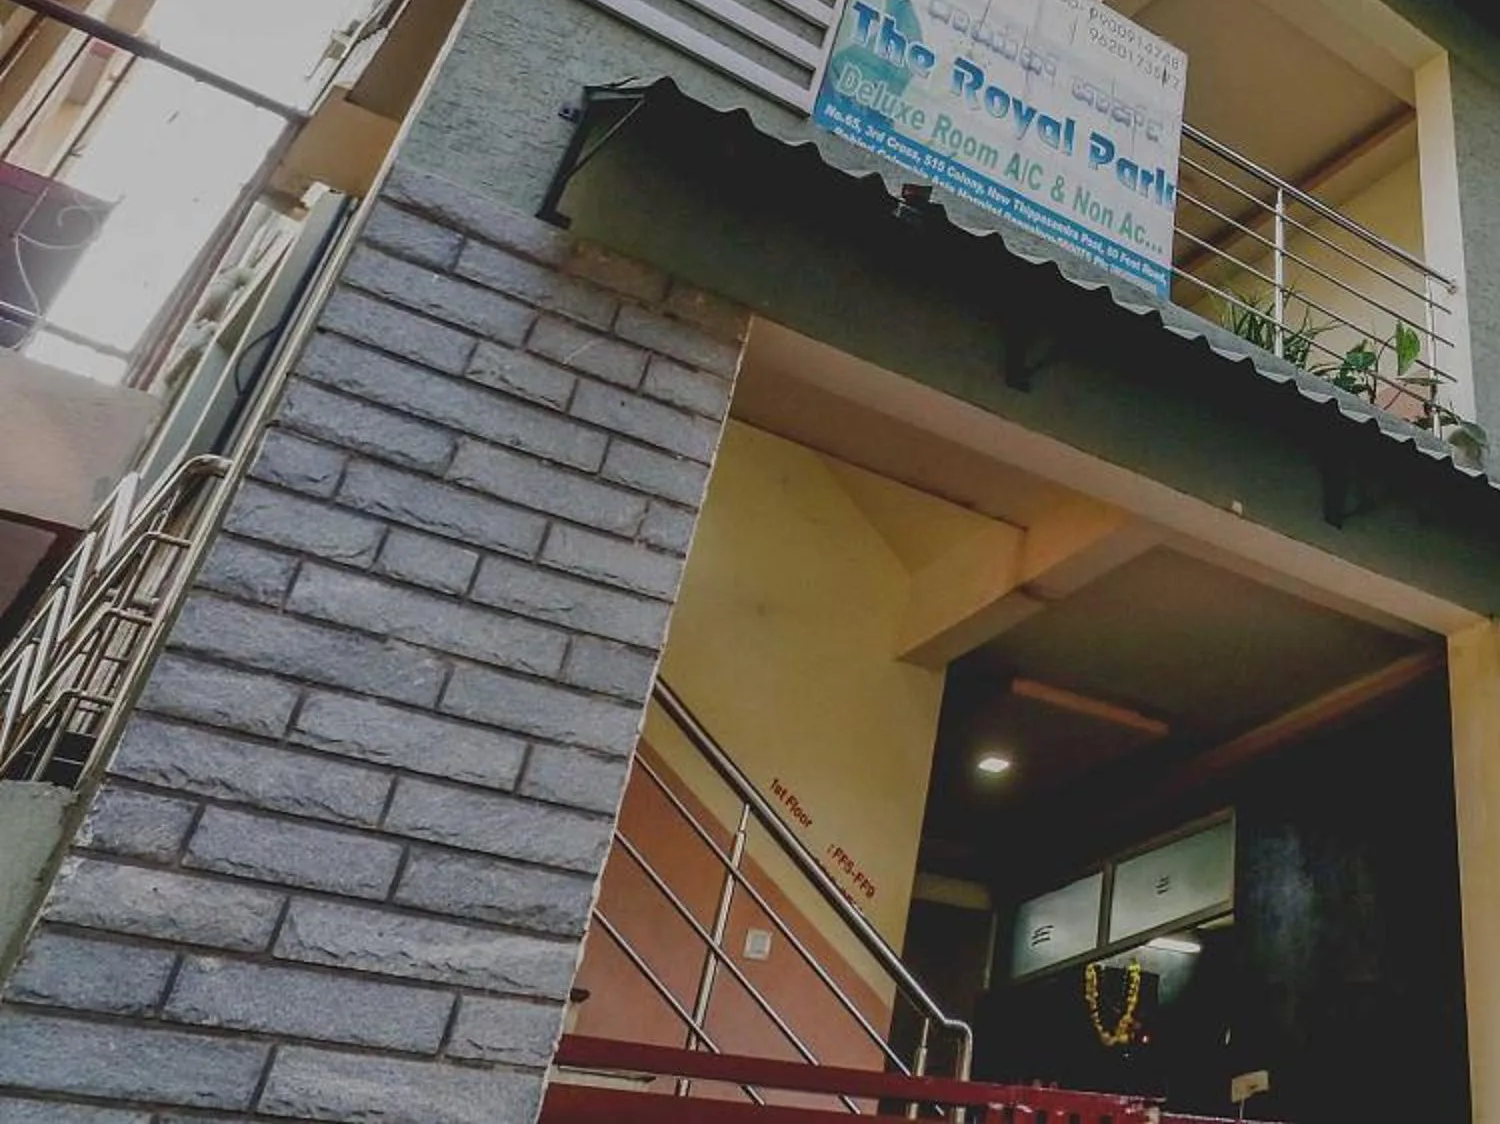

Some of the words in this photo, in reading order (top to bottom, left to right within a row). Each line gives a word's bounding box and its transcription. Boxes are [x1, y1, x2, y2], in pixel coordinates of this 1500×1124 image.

[838, 64, 926, 130] Deluxe
[931, 114, 999, 169] Room
[1005, 153, 1043, 190] A/C
[1051, 175, 1065, 204] &
[1073, 185, 1113, 228] Non
[853, 1, 935, 80] The
[952, 56, 1076, 156] Royal
[770, 778, 787, 801] 1st
[785, 795, 813, 827] Floor
